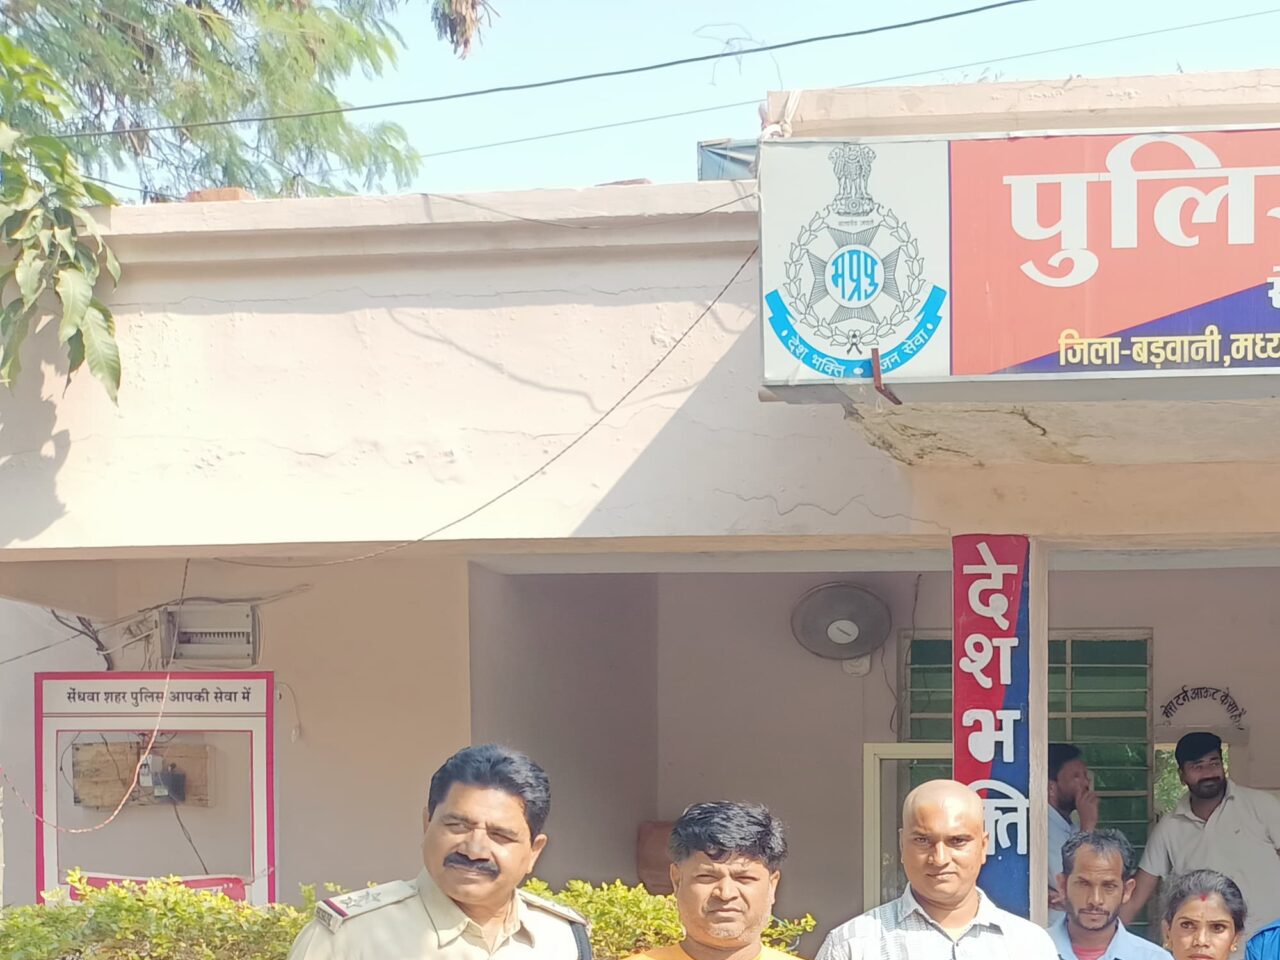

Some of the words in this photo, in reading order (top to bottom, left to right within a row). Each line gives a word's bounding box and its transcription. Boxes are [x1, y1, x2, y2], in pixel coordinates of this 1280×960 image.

[788, 334, 808, 359] देश
[811, 354, 846, 378] भक्ति
[902, 329, 930, 354] सेवा
[67, 687, 100, 703] सेंधवा
[104, 691, 127, 704] शहर
[131, 687, 165, 707] पुलिस
[170, 688, 210, 703] आपकी
[214, 687, 238, 703] सेवा
[241, 686, 252, 703] में
